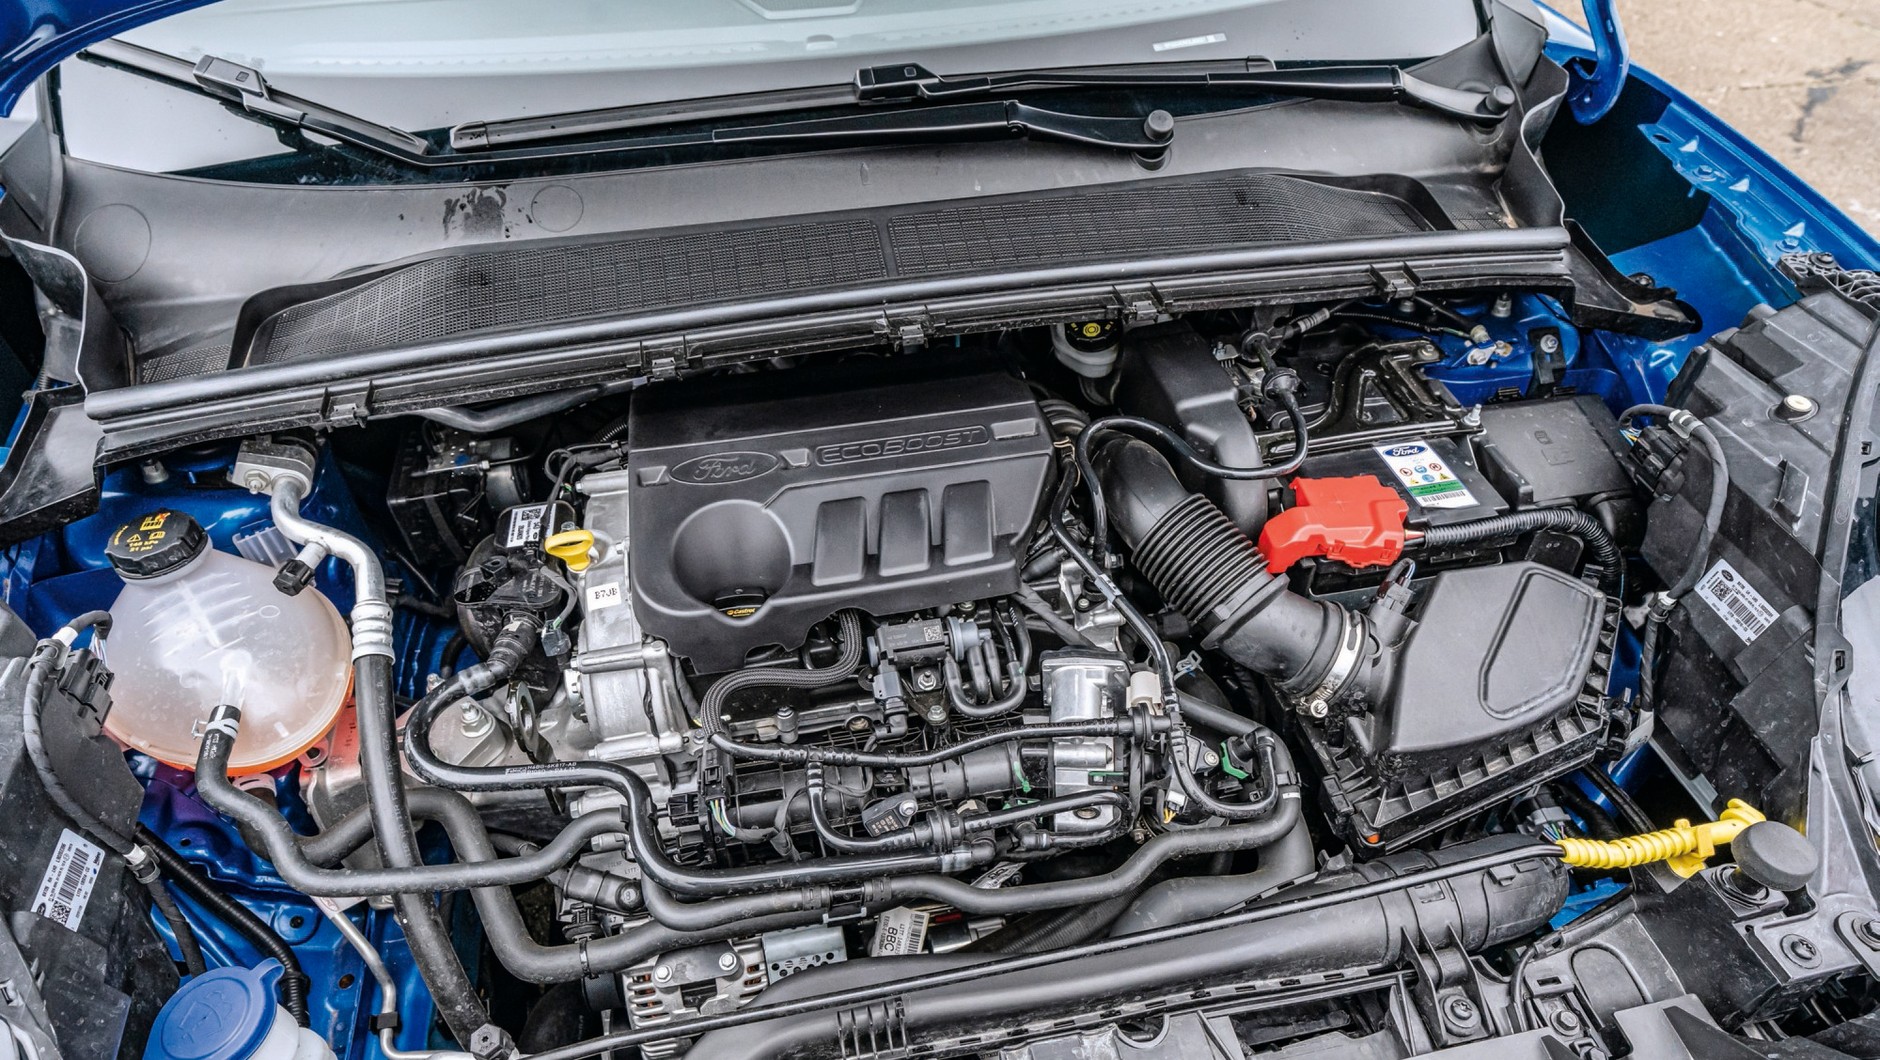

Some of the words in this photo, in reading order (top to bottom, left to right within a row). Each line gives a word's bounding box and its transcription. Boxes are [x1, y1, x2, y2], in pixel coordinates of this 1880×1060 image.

[822, 430, 981, 463] ECOBOOST
[1392, 446, 1420, 457] Ford
[693, 457, 756, 480] Ford
[594, 587, 618, 600] B7JB
[884, 926, 898, 952] BBC
